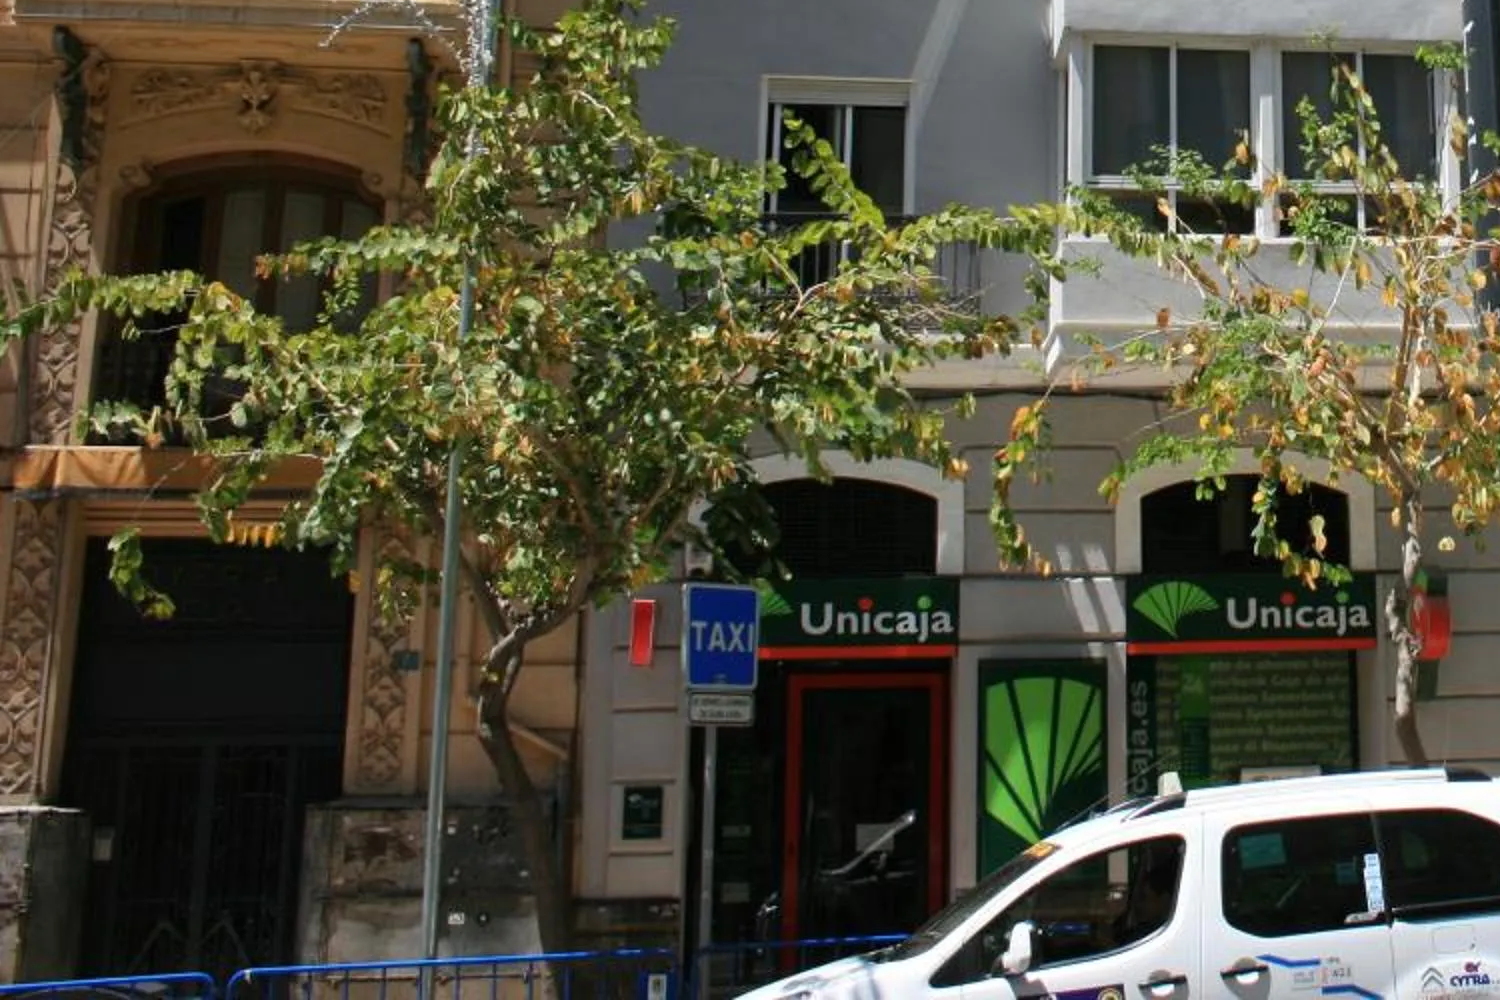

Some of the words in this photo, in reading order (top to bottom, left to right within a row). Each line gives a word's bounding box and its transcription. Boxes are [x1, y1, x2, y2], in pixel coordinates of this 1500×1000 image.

[691, 620, 755, 652] TAXI
[801, 595, 954, 643] Unicaja
[1226, 592, 1371, 637] Unicaja
